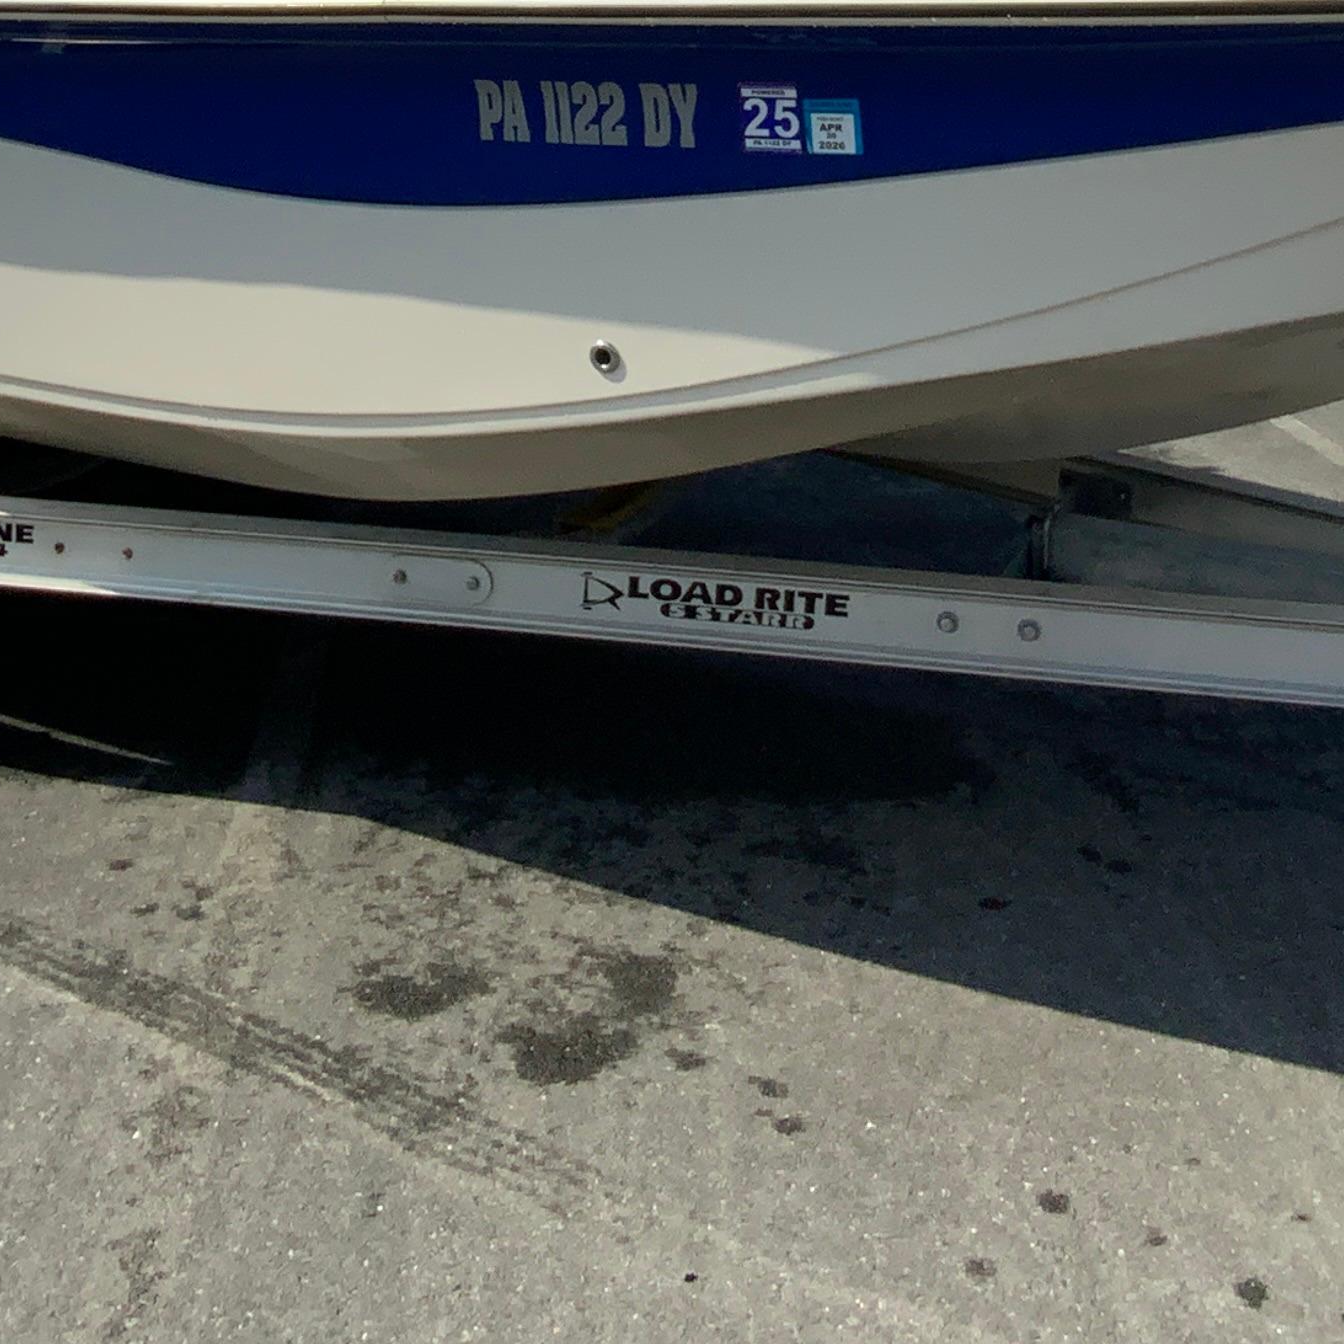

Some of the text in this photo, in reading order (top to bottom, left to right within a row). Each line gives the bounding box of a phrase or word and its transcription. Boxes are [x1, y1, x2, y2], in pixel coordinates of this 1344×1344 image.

[473, 78, 699, 149] PA 1122 DY
[743, 97, 800, 139] 25
[819, 122, 843, 132] APR
[818, 141, 846, 151] 2026
[627, 575, 851, 619] LOAD RITE
